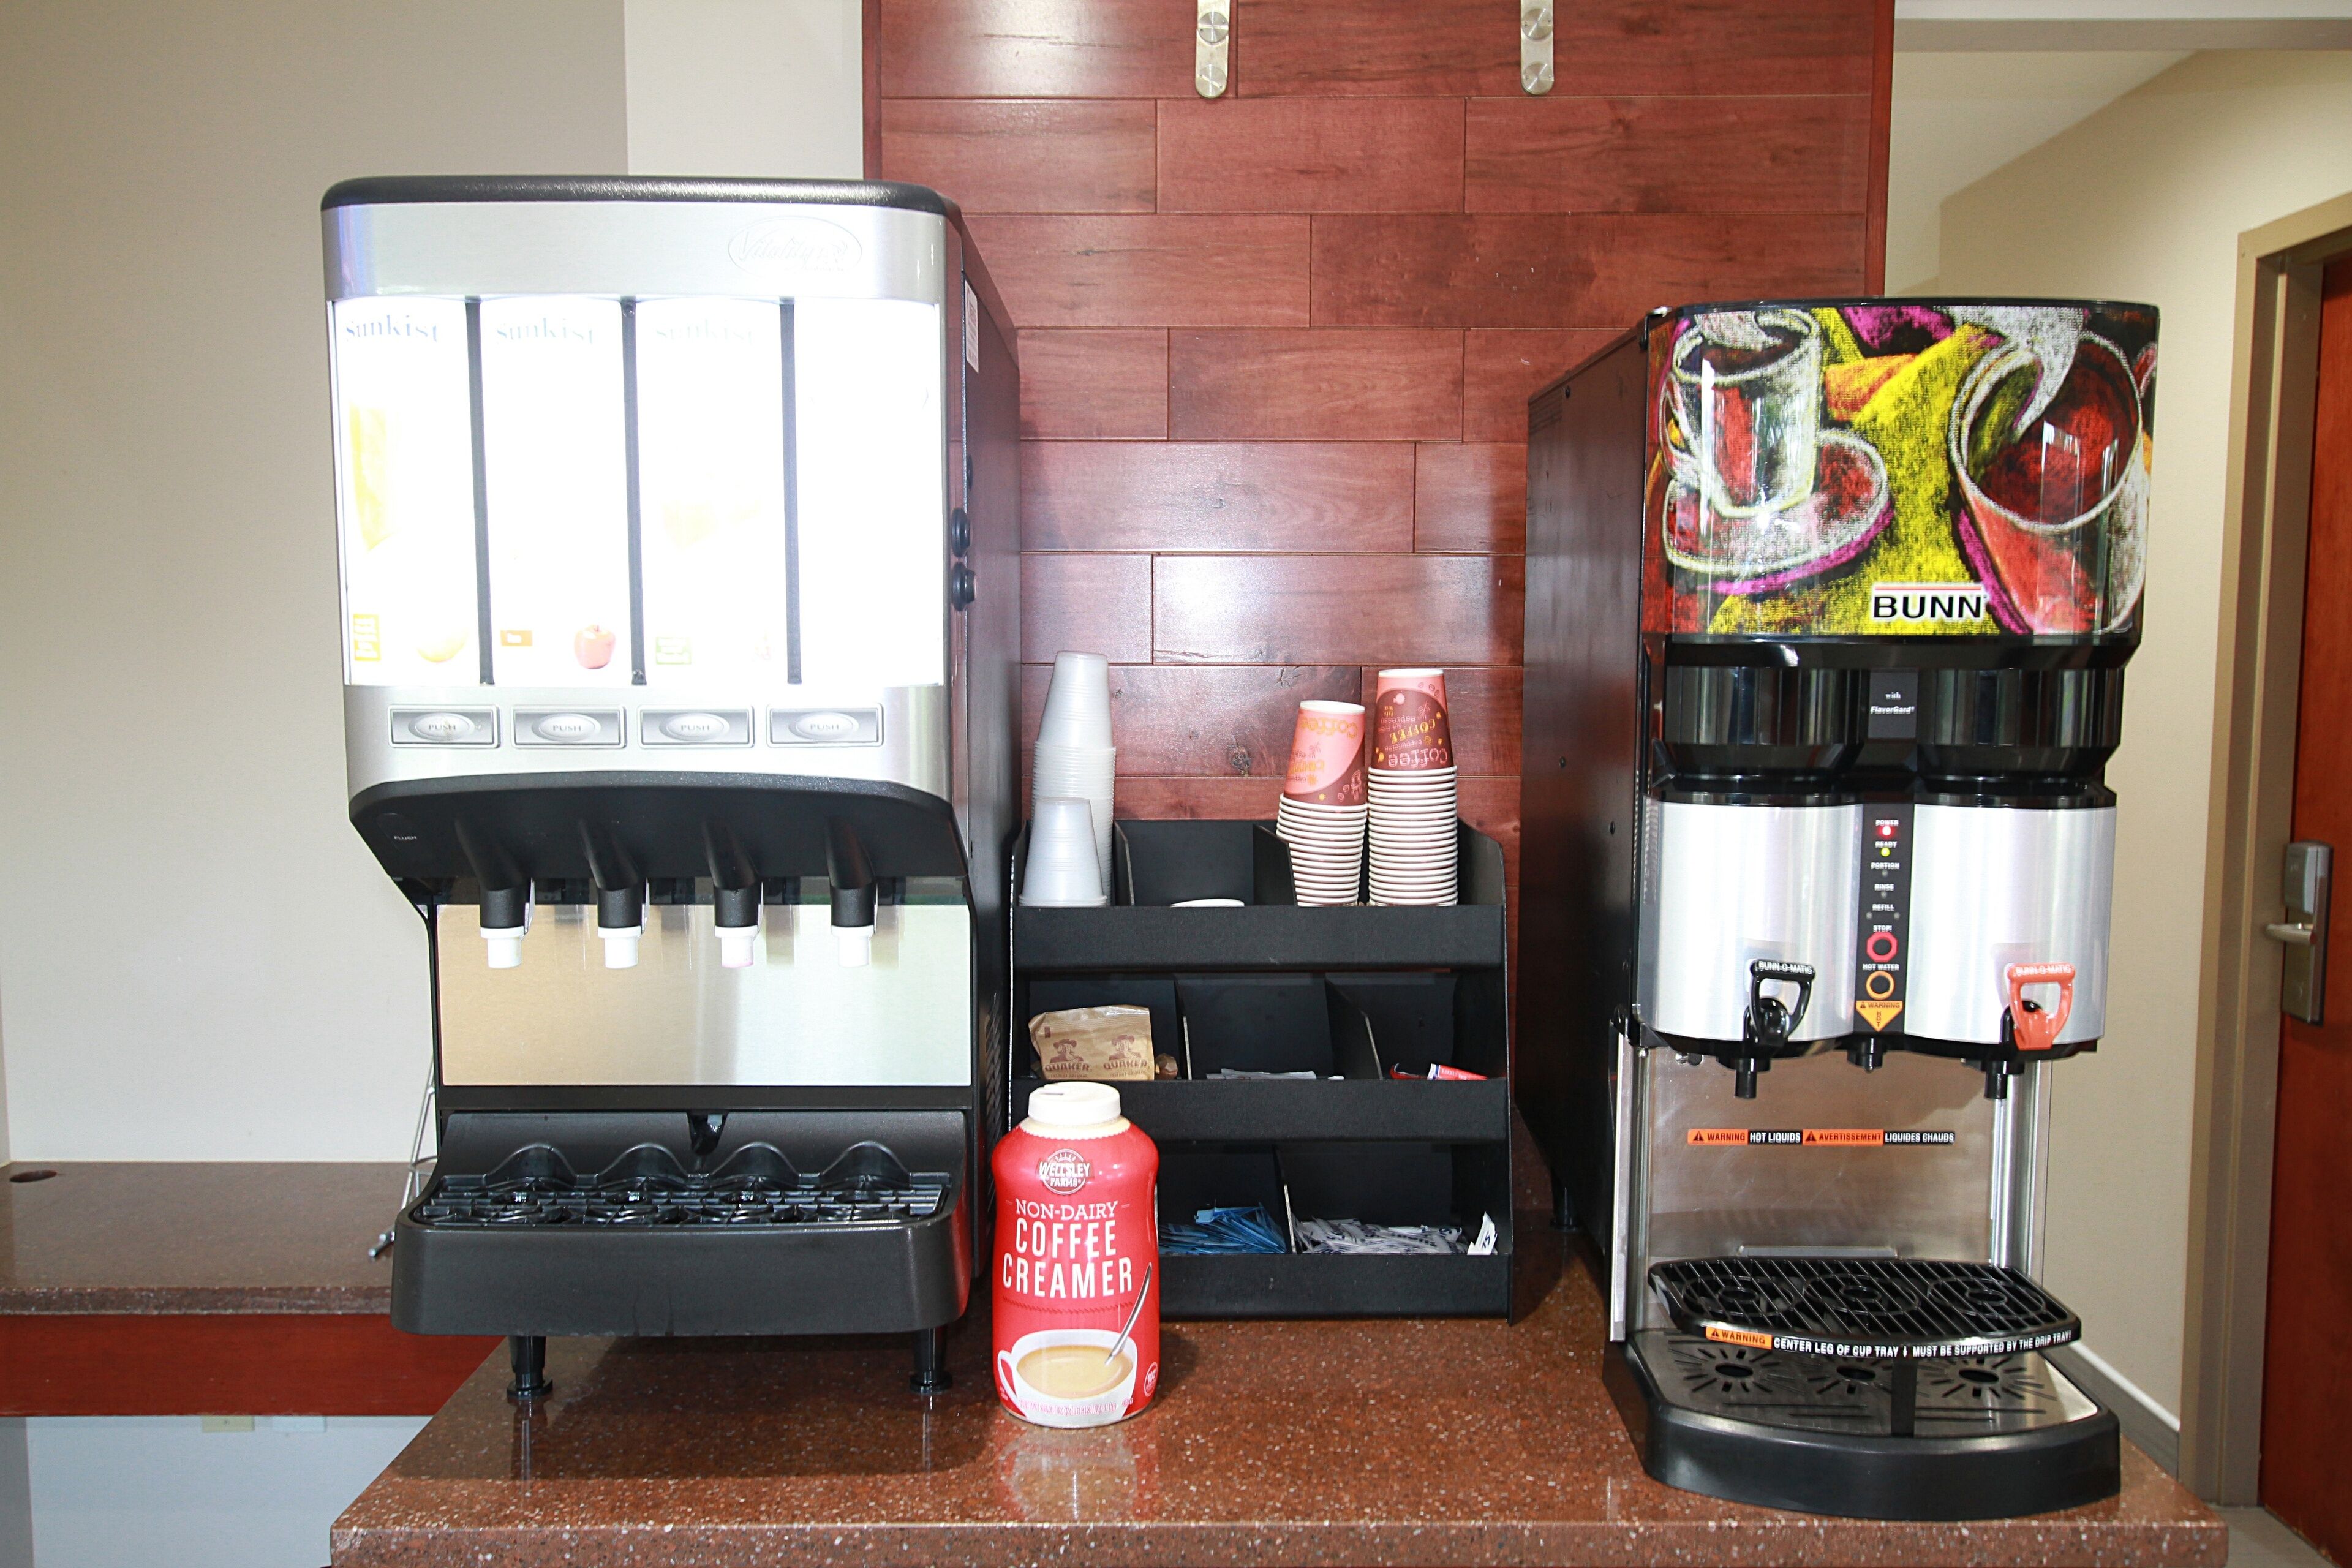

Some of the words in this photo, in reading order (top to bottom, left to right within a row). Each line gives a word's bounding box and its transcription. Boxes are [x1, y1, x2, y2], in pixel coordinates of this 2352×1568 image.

[1874, 594, 1982, 619] BUNN
[1381, 715, 1416, 725] espresso
[1389, 719, 1436, 744] COFFEE
[1388, 748, 1448, 768] Coffee
[1044, 1063, 1090, 1072] QUAKER
[1750, 1132, 1766, 1142] HOT
[1768, 1132, 1801, 1143] LIQUIDS
[1819, 1133, 1881, 1141] AVERTISSEMENT
[1885, 1133, 1920, 1142] LIQUIDES
[1923, 1133, 1954, 1143] CHAUDS
[1039, 1161, 1090, 1180] WELLSLEY
[1016, 1198, 1118, 1220] NON-DAIRY
[1016, 1218, 1117, 1259] COFFEE
[1003, 1253, 1132, 1299] CREAMER
[1722, 1330, 1765, 1344] WARNING
[1774, 1337, 1812, 1352] CENTER
[1814, 1342, 1834, 1355] LEG
[1836, 1344, 1849, 1356] OF
[1852, 1345, 1872, 1357] CUP
[1875, 1346, 1899, 1358] TRAY
[1913, 1345, 1937, 1357] MUST
[1940, 1345, 1952, 1356] BE
[1954, 1343, 2005, 1356] SUPPORTED
[2007, 1341, 2017, 1352] BY
[2019, 1338, 2034, 1350] THE
[2035, 1335, 2051, 1347] DRIP
[2052, 1330, 2072, 1343] TRAY!
